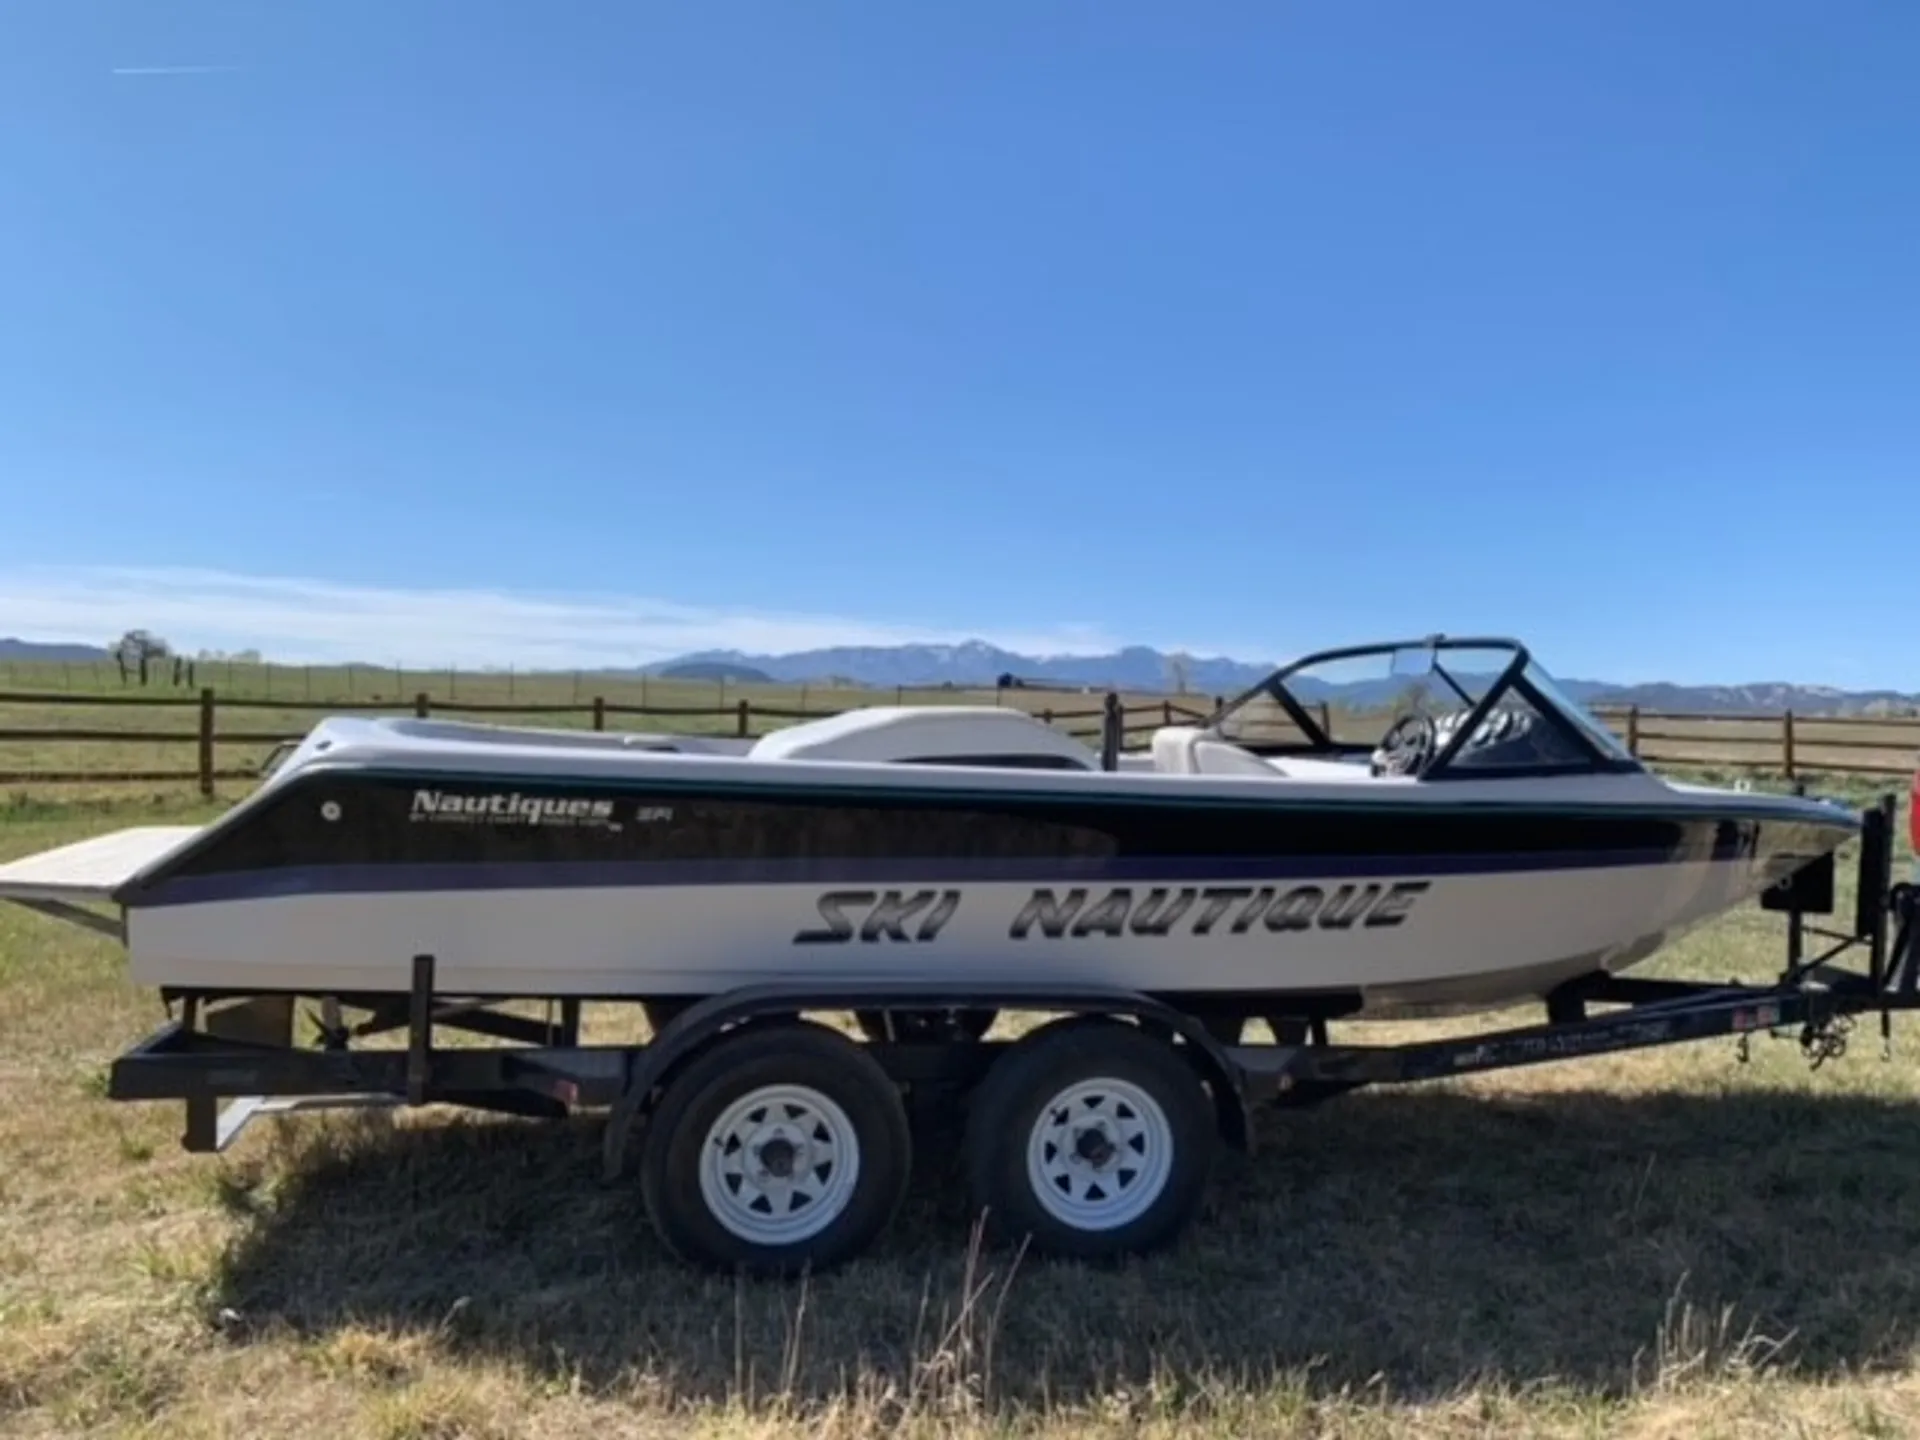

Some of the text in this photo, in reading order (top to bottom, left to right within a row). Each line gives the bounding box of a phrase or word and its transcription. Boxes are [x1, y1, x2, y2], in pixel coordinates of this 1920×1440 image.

[411, 789, 614, 825] Nautiques
[792, 880, 1432, 945] SKI NAUTIQUE
